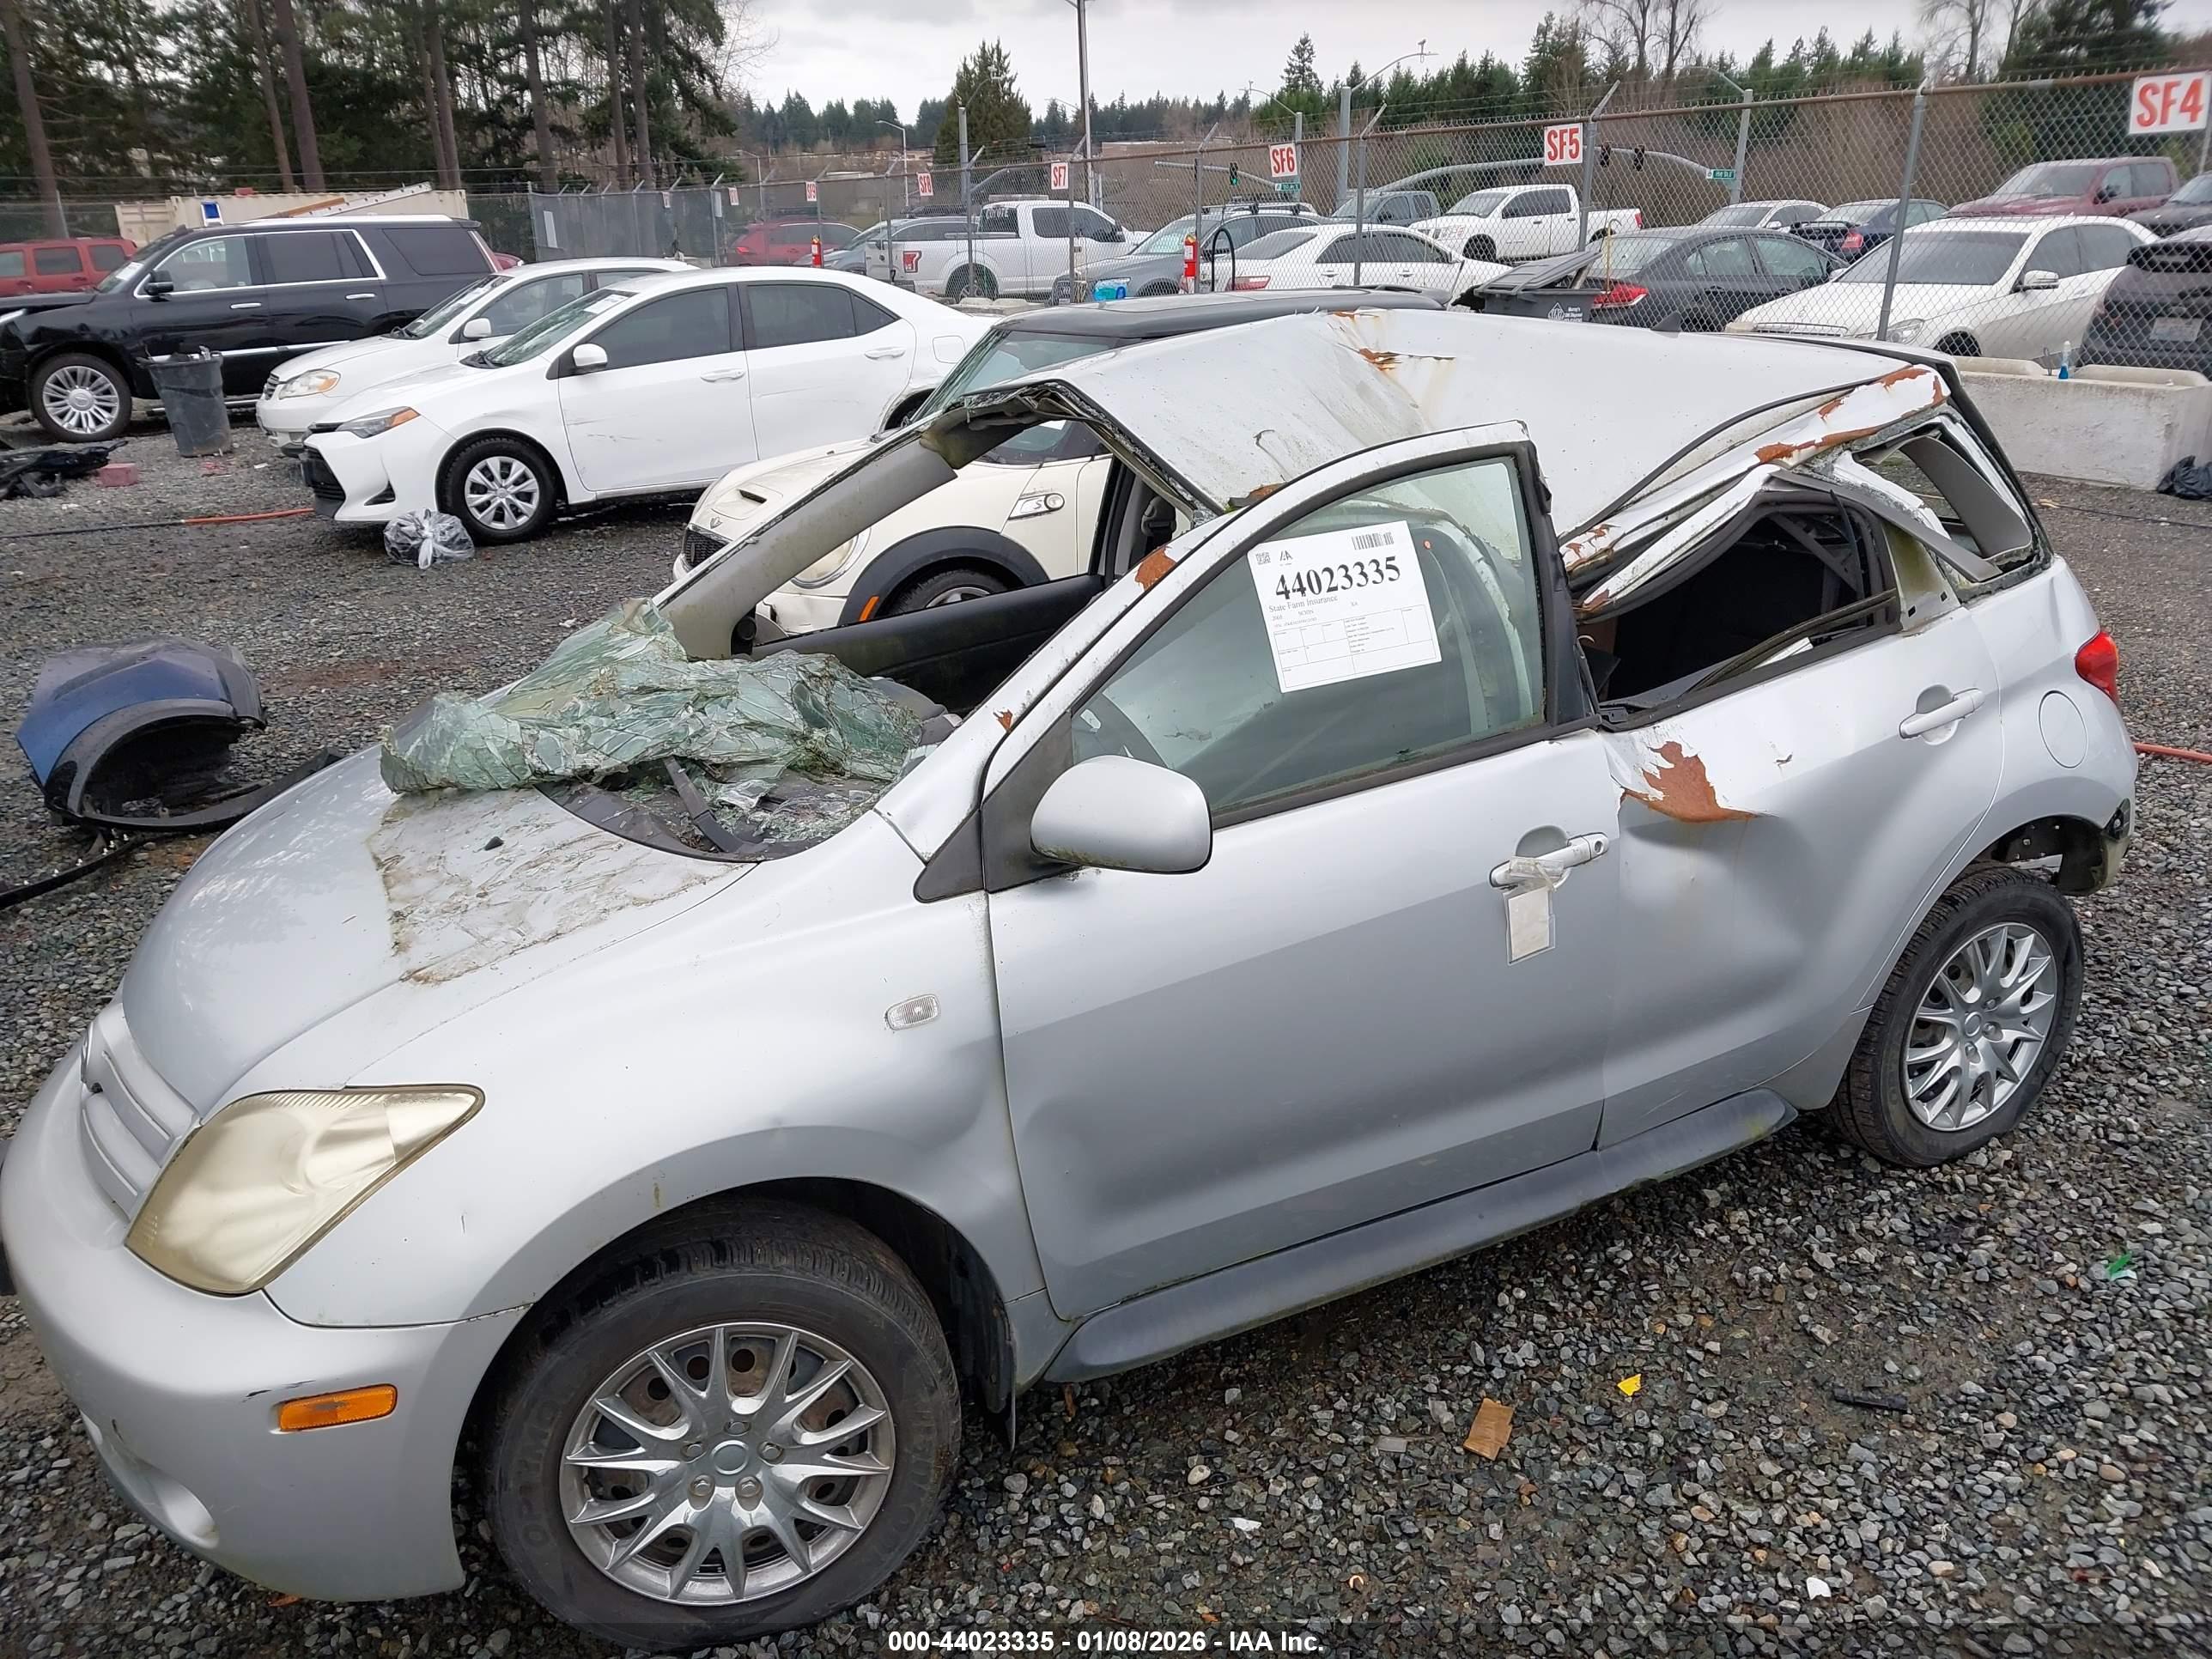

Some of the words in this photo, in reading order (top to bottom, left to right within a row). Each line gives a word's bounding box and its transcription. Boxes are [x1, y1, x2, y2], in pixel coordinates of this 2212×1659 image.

[2135, 78, 2203, 128] SF4
[1547, 126, 1580, 162] SF5
[1272, 148, 1295, 173] SF6
[920, 174, 933, 194] SF8
[1053, 166, 1066, 187] SF7
[806, 183, 817, 200] SF9
[1033, 500, 1042, 510] S
[1275, 556, 1401, 600] 44023335
[1268, 604, 1286, 613] State
[1287, 601, 1305, 610] Farm
[1307, 596, 1338, 606] Insurance
